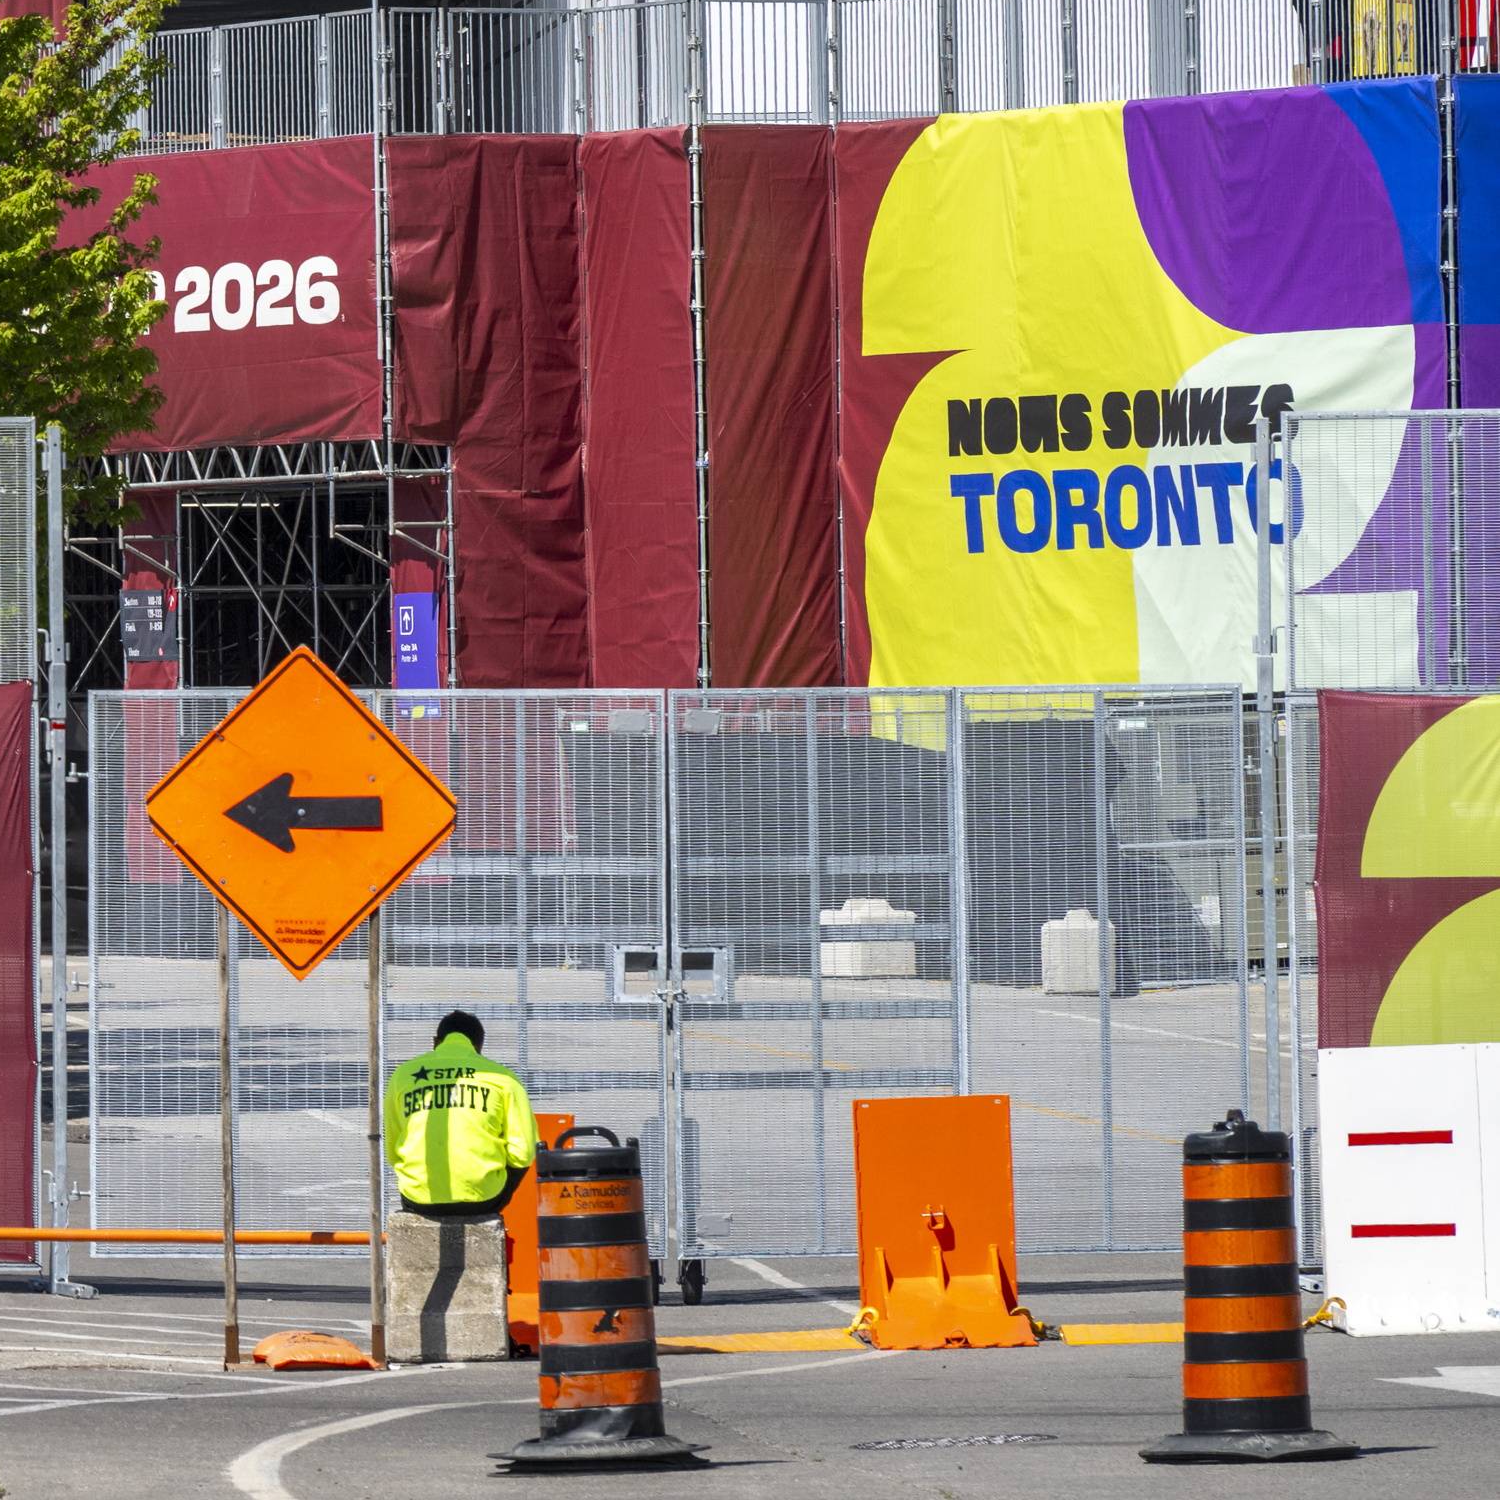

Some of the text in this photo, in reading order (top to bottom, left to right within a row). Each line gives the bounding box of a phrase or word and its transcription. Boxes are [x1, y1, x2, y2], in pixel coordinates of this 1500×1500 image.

[174, 255, 340, 333] 2026
[948, 393, 1092, 457] NOUS
[950, 458, 1304, 554] TORONTO
[403, 1083, 490, 1118] SECURITY
[433, 1067, 476, 1079] STAR
